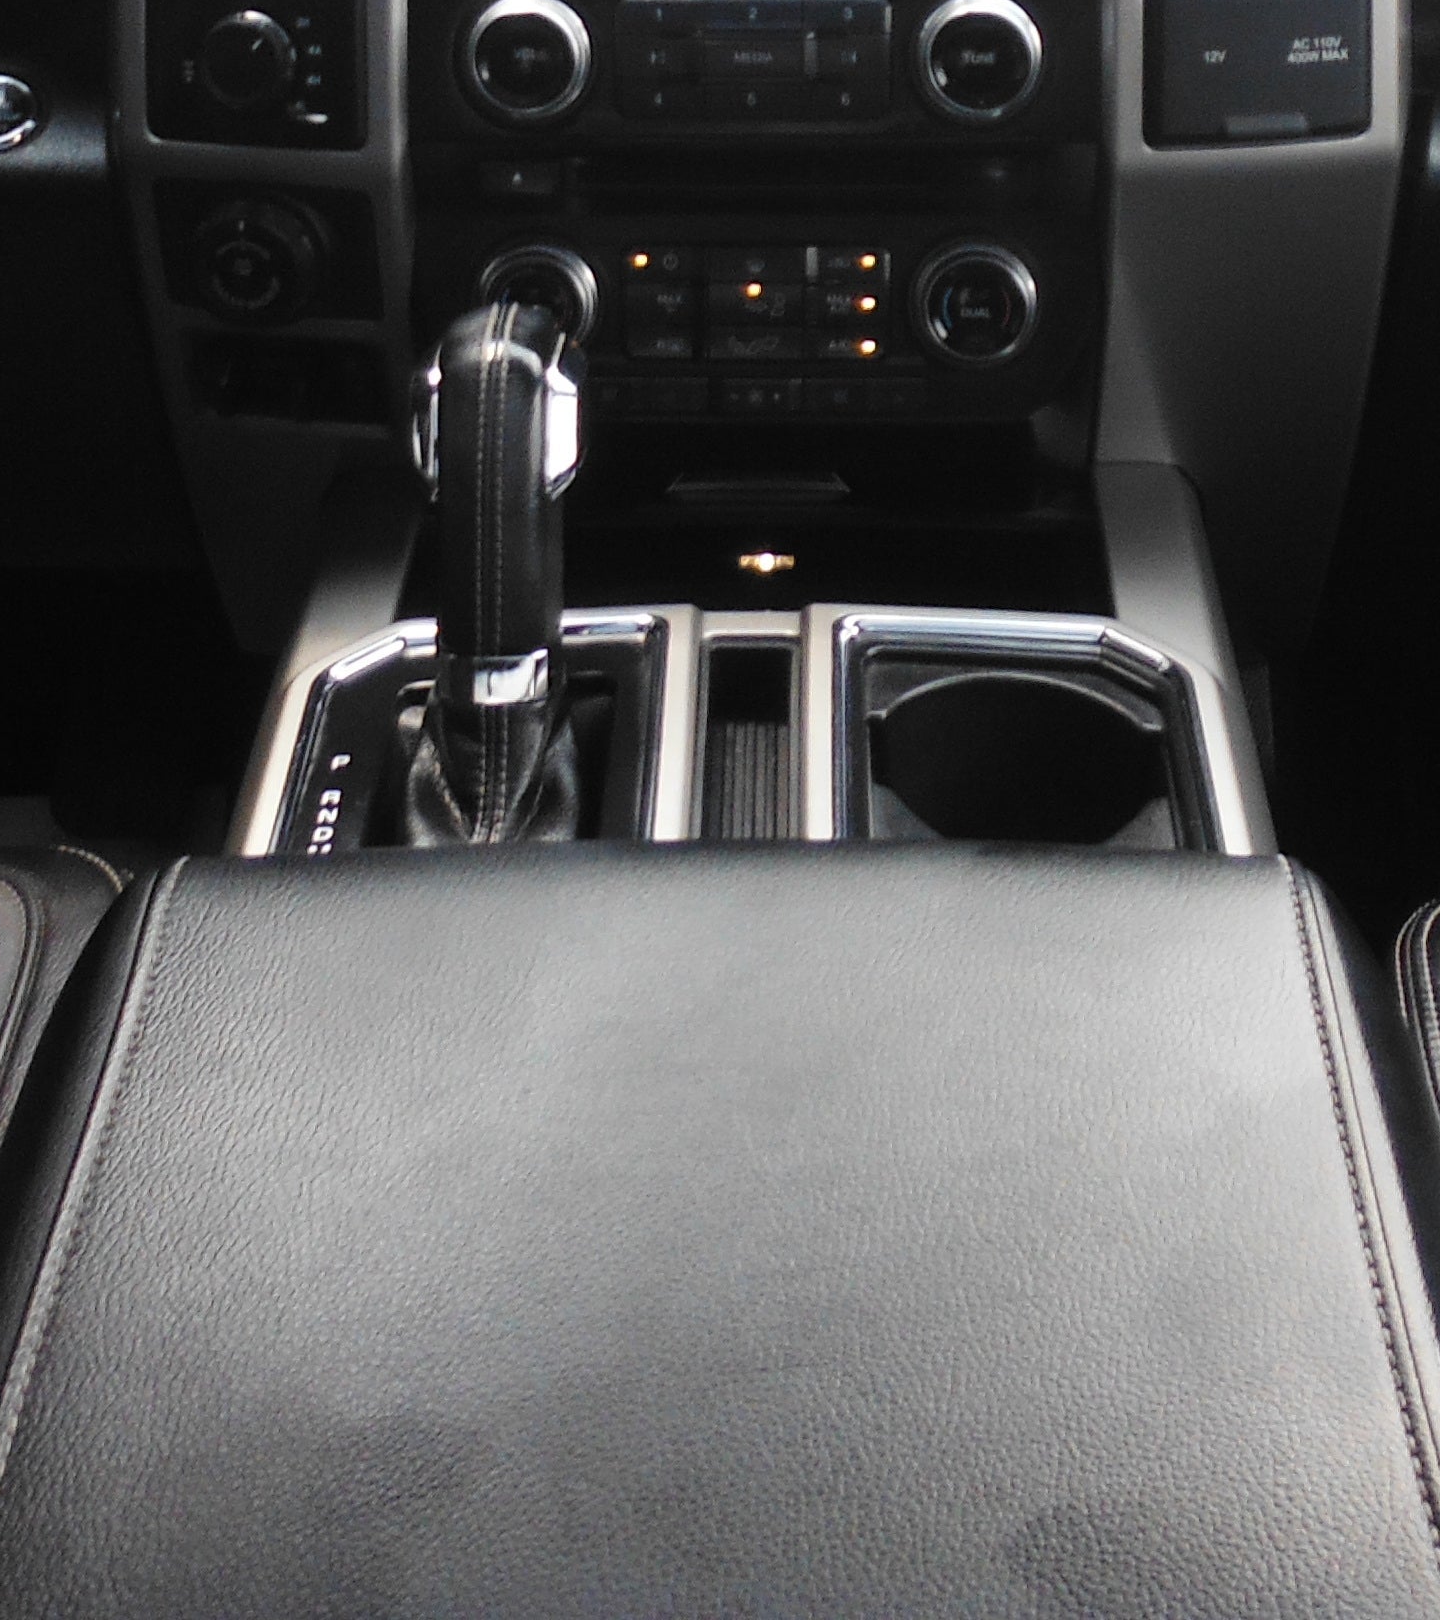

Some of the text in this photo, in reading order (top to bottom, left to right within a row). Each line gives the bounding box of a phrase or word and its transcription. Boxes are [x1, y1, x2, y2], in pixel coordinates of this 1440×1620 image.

[748, 6, 759, 21] 2
[843, 6, 854, 21] 3
[1292, 34, 1343, 51] AC 110V
[1201, 49, 1228, 65] 12V
[1287, 48, 1350, 65] 400W MAX
[330, 753, 351, 771] P
[320, 789, 342, 806] R
[317, 807, 339, 824] N
[311, 826, 334, 843] D
